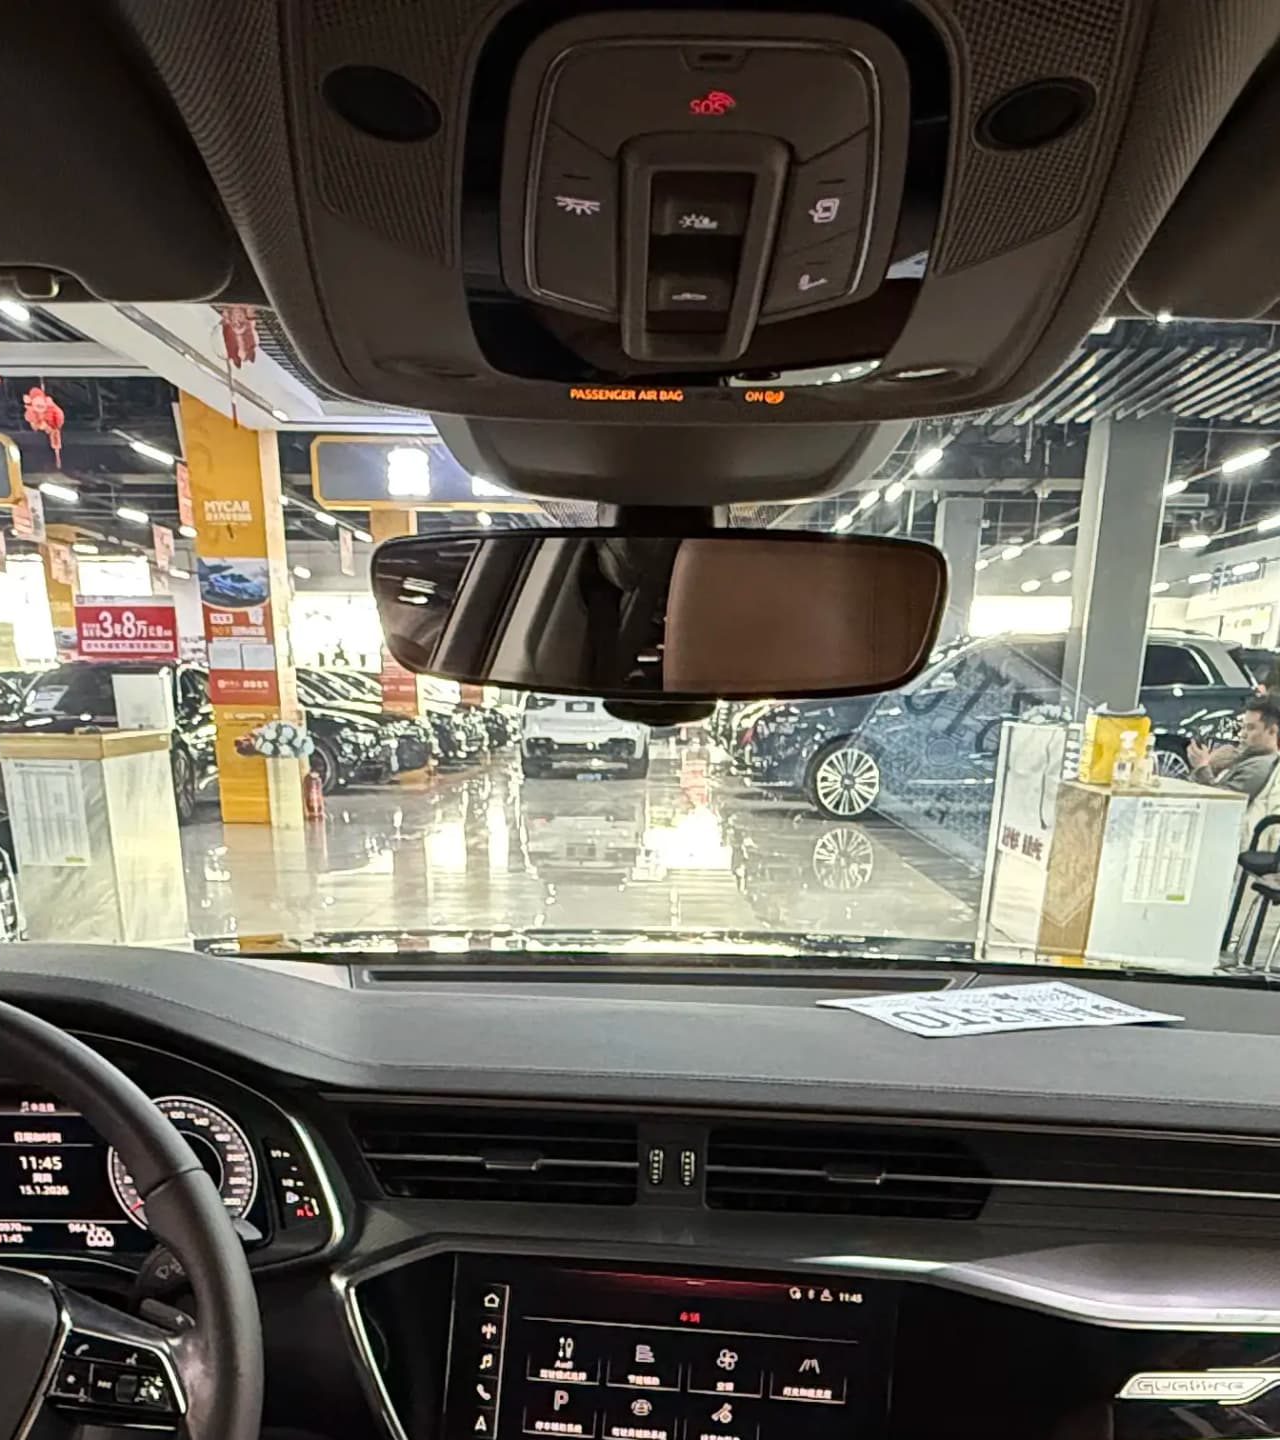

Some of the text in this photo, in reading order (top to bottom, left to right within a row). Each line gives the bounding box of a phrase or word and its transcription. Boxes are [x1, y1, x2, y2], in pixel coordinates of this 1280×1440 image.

[690, 99, 725, 115] SOS
[570, 388, 684, 402] PASSENGER AIR BAG
[745, 391, 764, 402] ON
[203, 500, 251, 513] MYCAR
[19, 1156, 63, 1171] 11:45
[19, 1185, 70, 1197] 15.1.2026
[838, 1292, 863, 1304] 11:45
[1136, 1379, 1245, 1396] quattro
[553, 1389, 569, 1411] P
